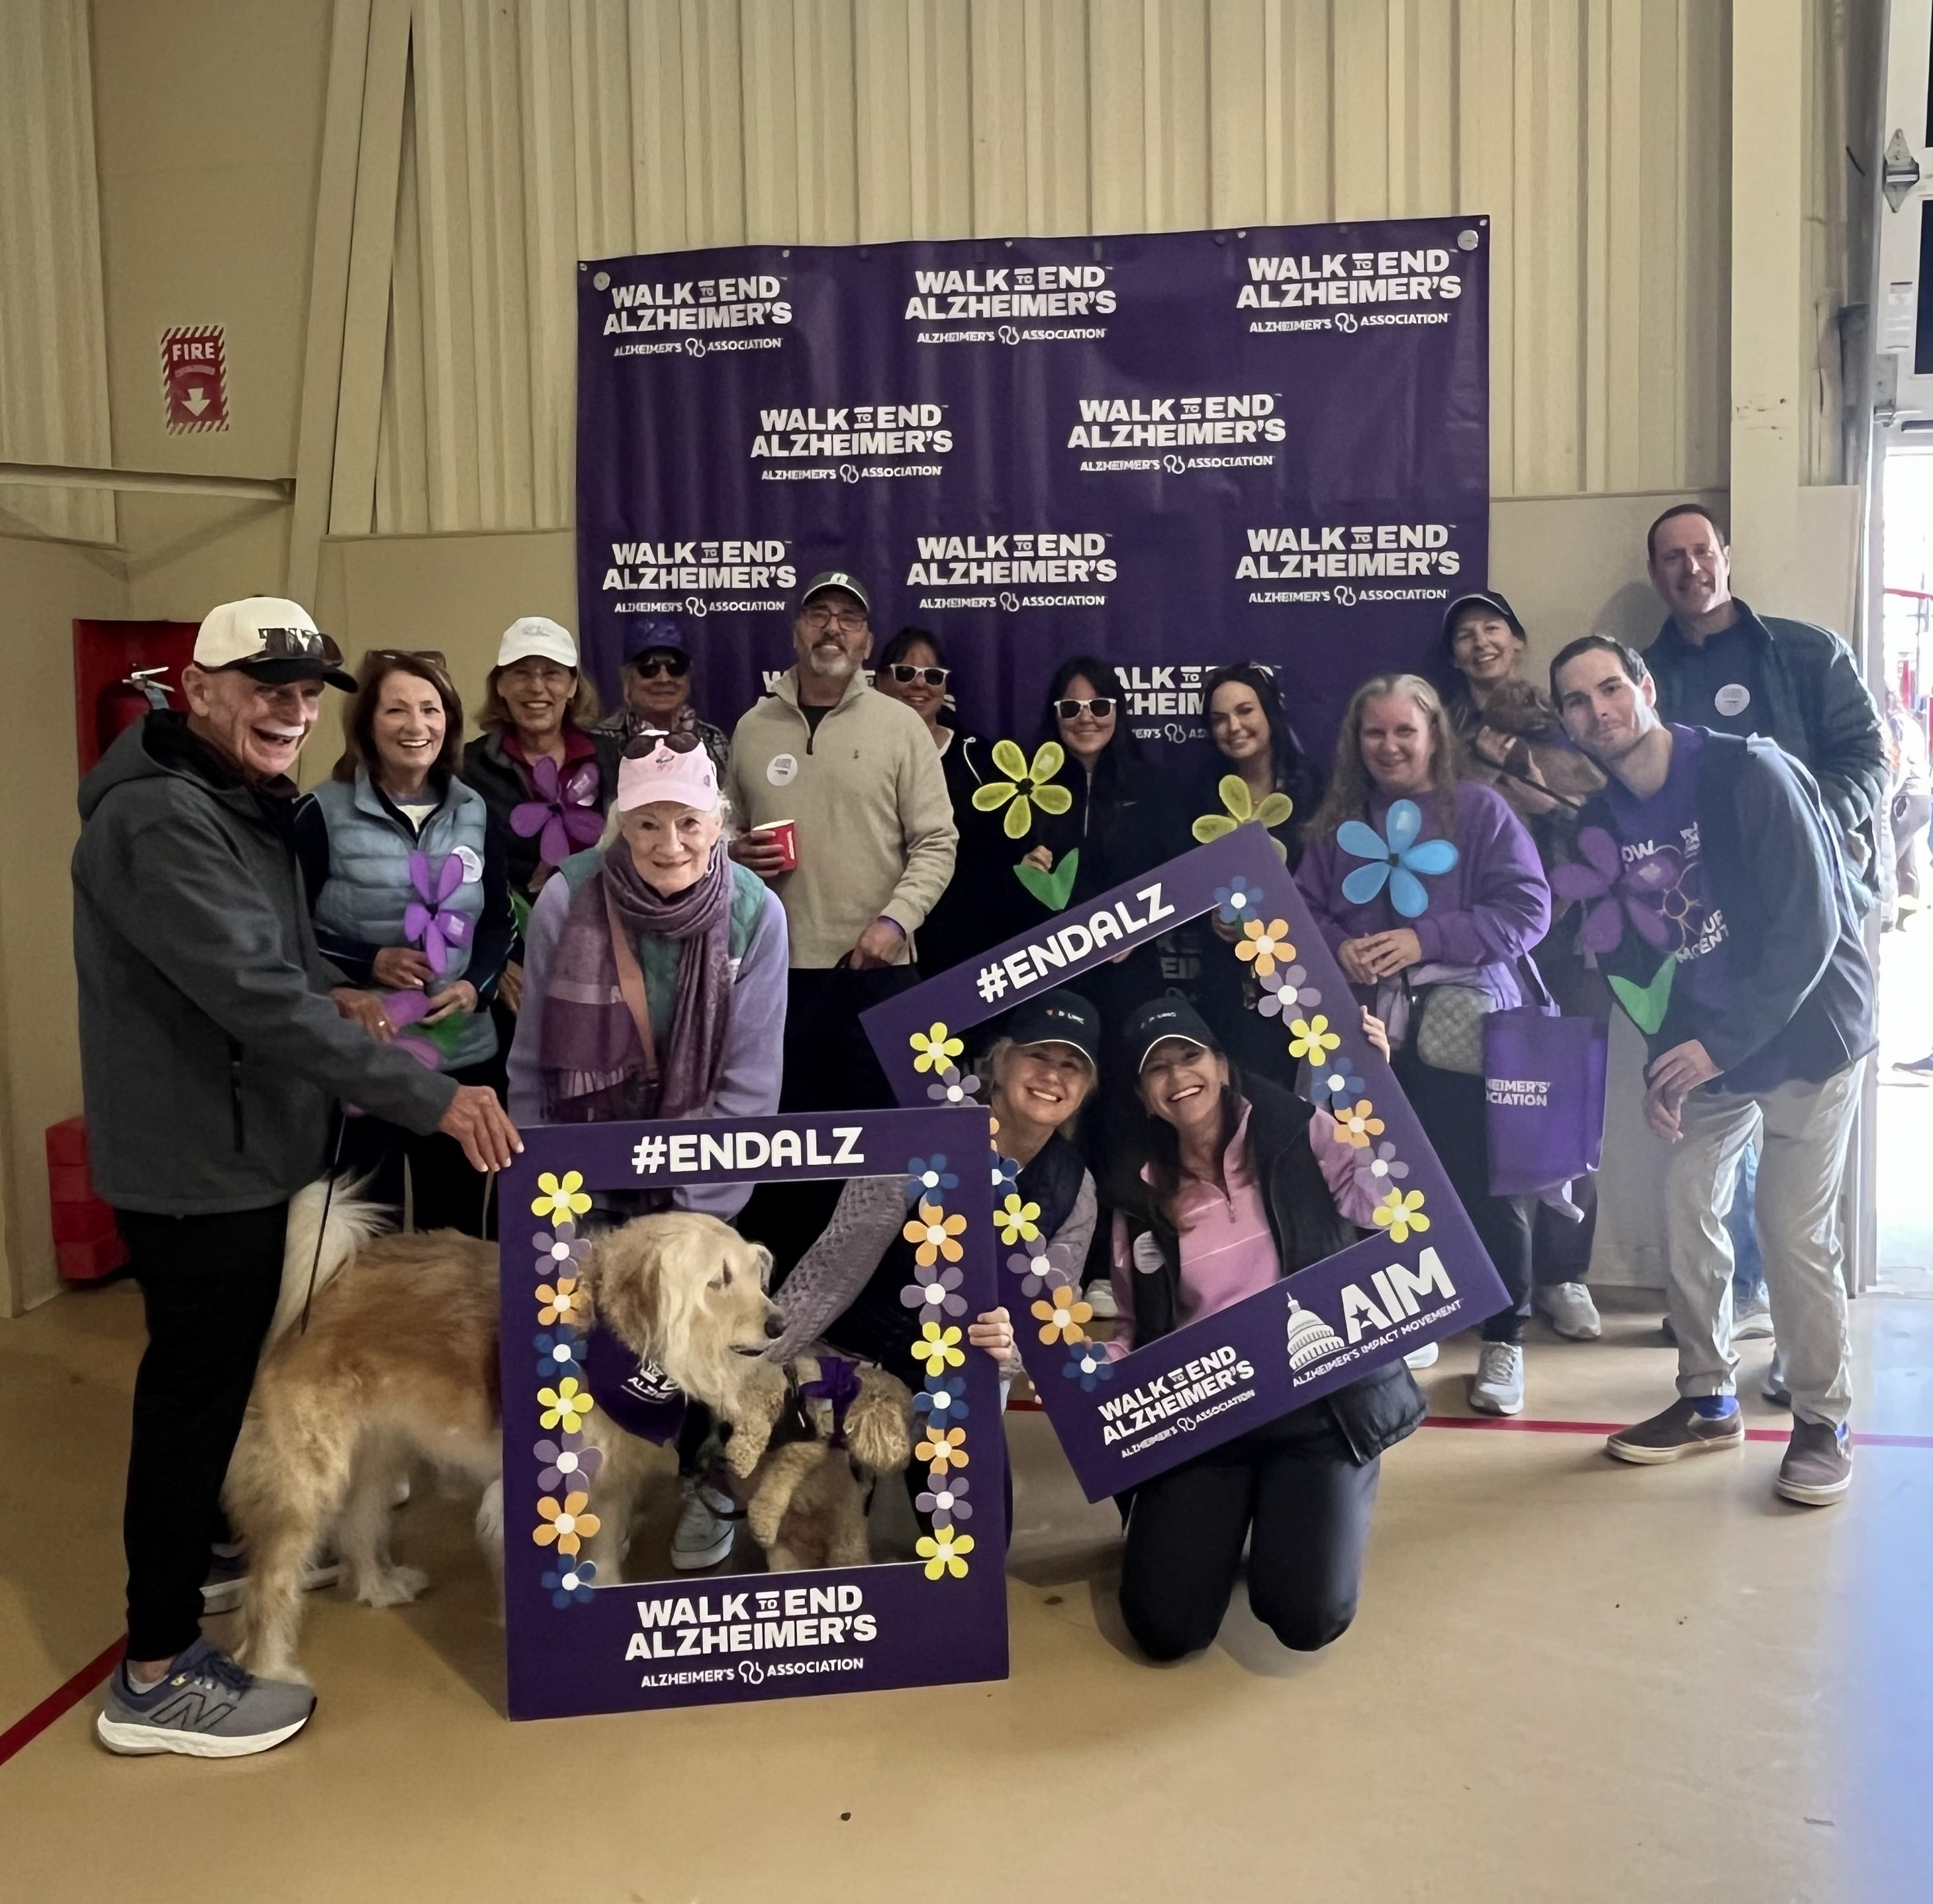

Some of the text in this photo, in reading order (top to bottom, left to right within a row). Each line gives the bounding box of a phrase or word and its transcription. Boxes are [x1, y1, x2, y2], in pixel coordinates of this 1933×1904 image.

[1249, 250, 1449, 281] WALK TO END
[612, 276, 780, 309] WALK TO END
[916, 266, 1105, 293] WALK TO END
[1237, 276, 1461, 308] ALZHEIMER'S
[604, 302, 792, 335] ALZHEIMER'S
[905, 291, 1116, 319] ALZHEIMER'S
[1361, 313, 1448, 326] ASSOCIATION
[708, 338, 781, 350] ASSOCIATION
[1022, 328, 1106, 340] ASSOCIATION
[172, 342, 215, 361] FIRE
[761, 405, 941, 431] WALK TO END
[1080, 395, 1274, 422] WALK TO END
[751, 430, 953, 457] ALZHEIMER'S
[1068, 418, 1286, 448] ALZHEIMER'S
[862, 466, 942, 477] ASSOCIATION
[1188, 455, 1272, 467] ASSOCIATION
[918, 534, 1105, 559] WALK TO END
[1247, 525, 1448, 552] WALK TO END
[612, 541, 784, 565] WALK TO END
[1235, 551, 1459, 579] ALZHEIMER'S
[603, 566, 796, 590] ALZHEIMER'S
[907, 559, 1117, 585] ALZHEIMER'S
[710, 601, 785, 610] ASSOCIATION
[1022, 596, 1104, 606] ASSOCIATION
[1359, 589, 1446, 600] ASSOCIATION
[1182, 673, 1200, 682] TO
[1622, 839, 1654, 862] OW
[976, 882, 1175, 1002] #ENDALZ
[632, 1127, 864, 1174] #ENDALZ
[1341, 1247, 1456, 1345] AIM
[1294, 1299, 1462, 1387] ALZHEIMER'S IMPACT MOVEMENT
[1098, 1376, 1170, 1422] WALK
[1185, 1347, 1236, 1380] END
[1104, 1360, 1255, 1445] ALZHEIMER'S
[637, 1586, 862, 1627] WALK TO END
[626, 1615, 876, 1660] ALZHEIMER'S
[767, 1658, 863, 1676] ASSOCIATION
